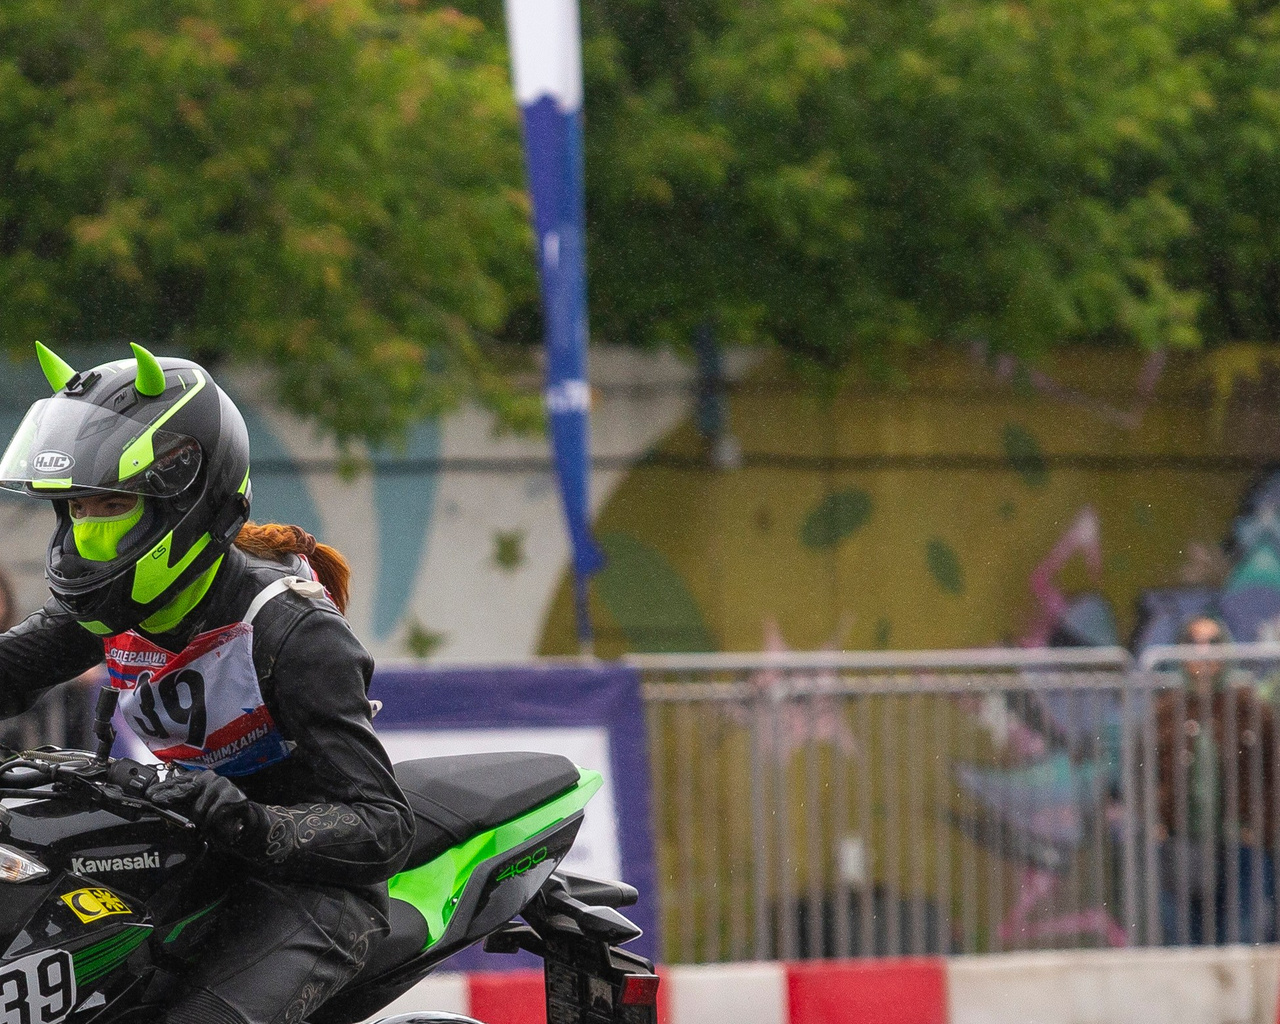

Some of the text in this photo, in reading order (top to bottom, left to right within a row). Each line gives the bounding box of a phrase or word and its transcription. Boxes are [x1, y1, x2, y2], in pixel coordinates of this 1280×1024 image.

[35, 456, 67, 468] HJC
[151, 545, 167, 560] CS
[71, 851, 161, 874] Kawasaki
[496, 846, 548, 882] 400
